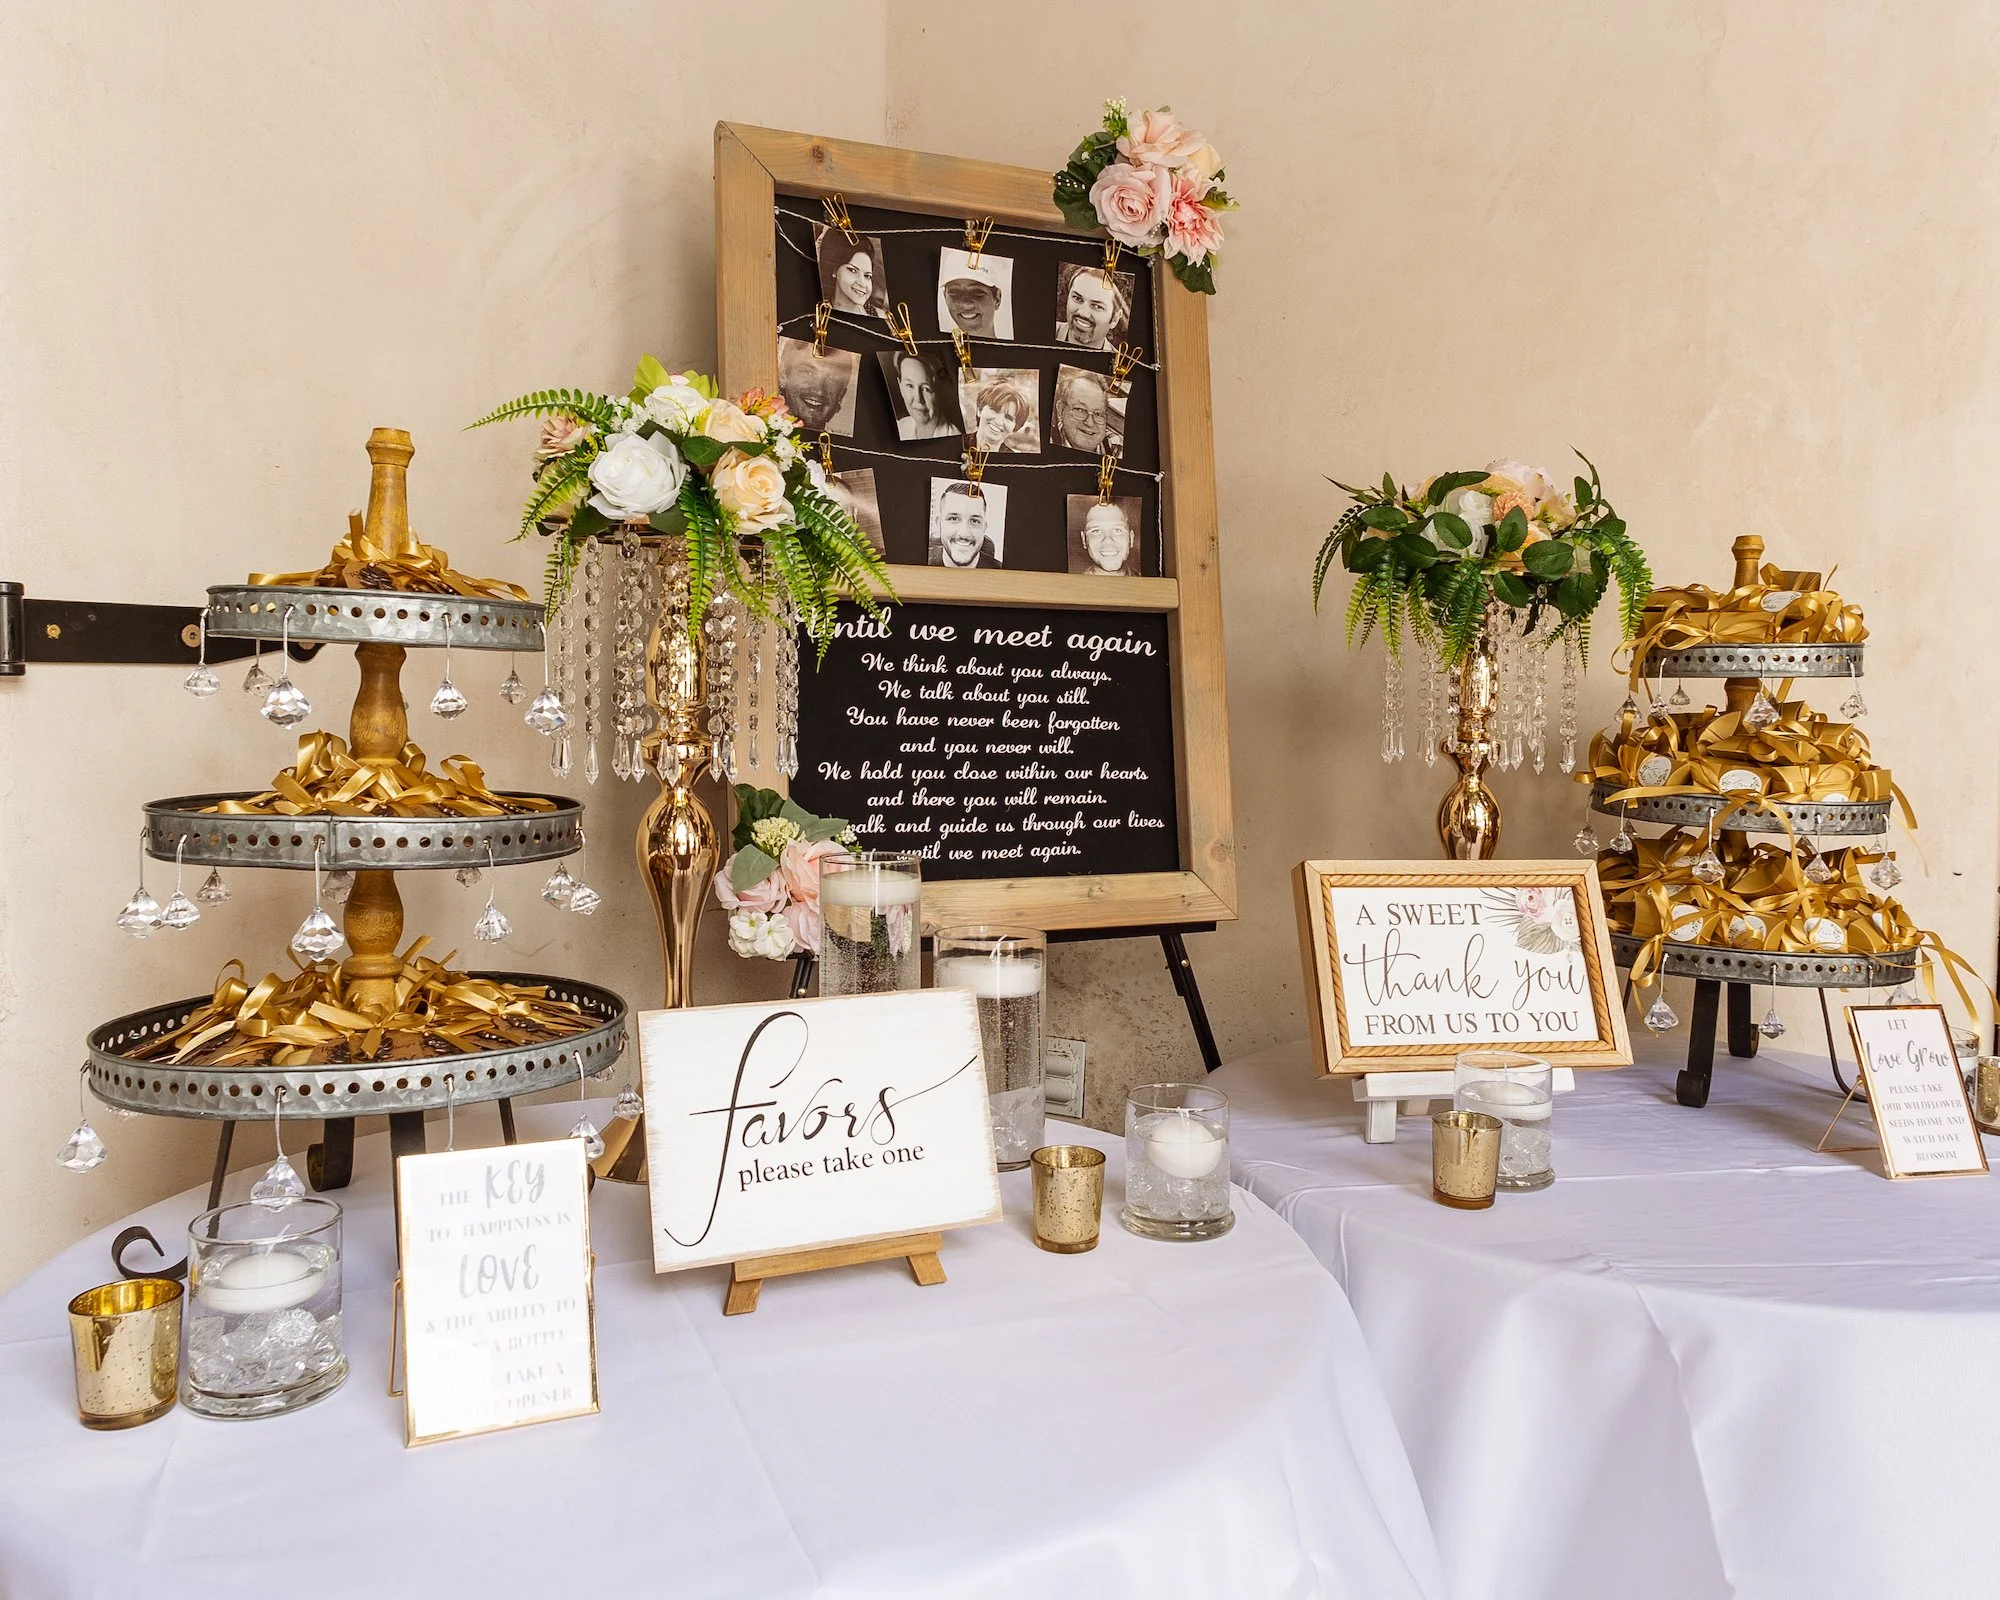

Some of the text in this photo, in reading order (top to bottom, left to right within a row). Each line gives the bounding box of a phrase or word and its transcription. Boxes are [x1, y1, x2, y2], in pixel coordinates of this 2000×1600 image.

[910, 624, 957, 641] we
[974, 625, 1052, 647] meet
[1067, 631, 1156, 661] again
[861, 653, 1111, 684] We think about you always.
[878, 680, 1090, 709] We talk about you still.
[847, 706, 1120, 735] You have never been forgotten
[900, 736, 1073, 759] and you never will.
[818, 760, 1148, 786] We hold you close within our hearts
[867, 787, 1107, 813] and there you will remain.
[895, 817, 931, 832] and
[940, 817, 988, 839] guide
[996, 823, 1015, 832] us
[1023, 811, 1086, 836] through
[1093, 819, 1120, 828] our
[1128, 810, 1165, 828] lives
[949, 850, 973, 859] we
[982, 844, 1023, 859] meet
[1031, 842, 1081, 861] again.
[1356, 903, 1482, 925] A SWEET
[1343, 928, 1585, 1010] thank you
[1365, 1011, 1578, 1035] FROM US TO YOU
[1888, 1020, 1908, 1030] LET
[1866, 1040, 1950, 1072] Love Grow
[1889, 1084, 1943, 1094] PLEASE TAKE
[1882, 1100, 1962, 1111] OUR WILDFLOWER
[664, 1011, 977, 1247] favors
[1888, 1116, 1965, 1128] SEEDS HOME AND
[1903, 1134, 1960, 1144] WATCH LOVE
[739, 1144, 925, 1191] please take one
[1916, 1151, 1957, 1161] BLOSSOM
[438, 1159, 546, 1209] THE KEY
[426, 1229, 451, 1243] TO
[462, 1213, 552, 1238] HAPPINESS
[459, 1244, 539, 1298] LOVE
[441, 1314, 477, 1331] THE
[484, 1303, 548, 1326] ABILITY
[555, 1298, 577, 1312] TO
